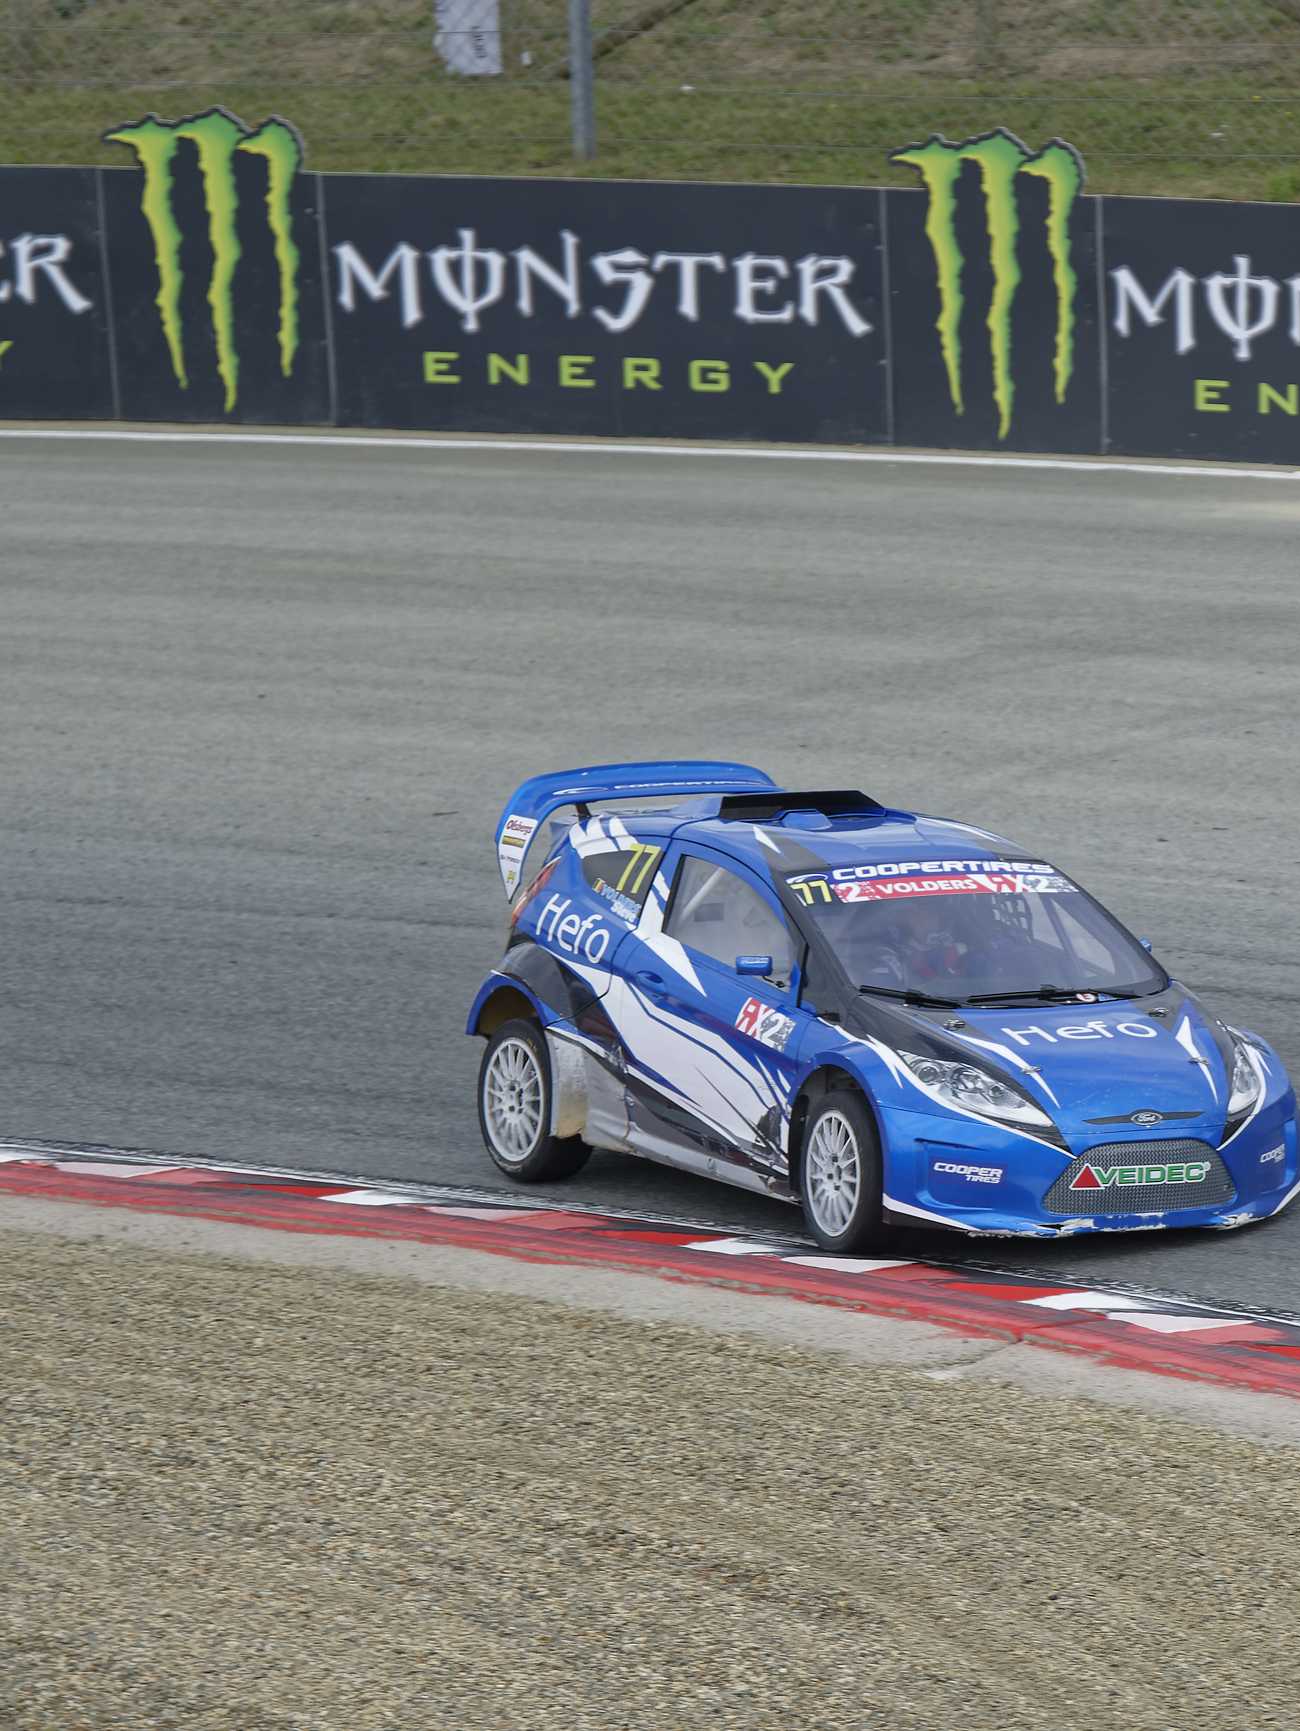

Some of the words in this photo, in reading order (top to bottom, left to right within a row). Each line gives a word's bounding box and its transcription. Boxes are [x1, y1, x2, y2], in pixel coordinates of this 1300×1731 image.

[334, 228, 873, 338] MONSTER
[423, 350, 793, 394] ENERGY
[615, 843, 662, 894] 77
[789, 880, 833, 905] 77
[876, 878, 979, 895] VOLDERS
[535, 892, 611, 965] Hefo
[1000, 1020, 1158, 1047] Hefo
[933, 1162, 1004, 1178] COOPER
[966, 1174, 1001, 1184] TIRES
